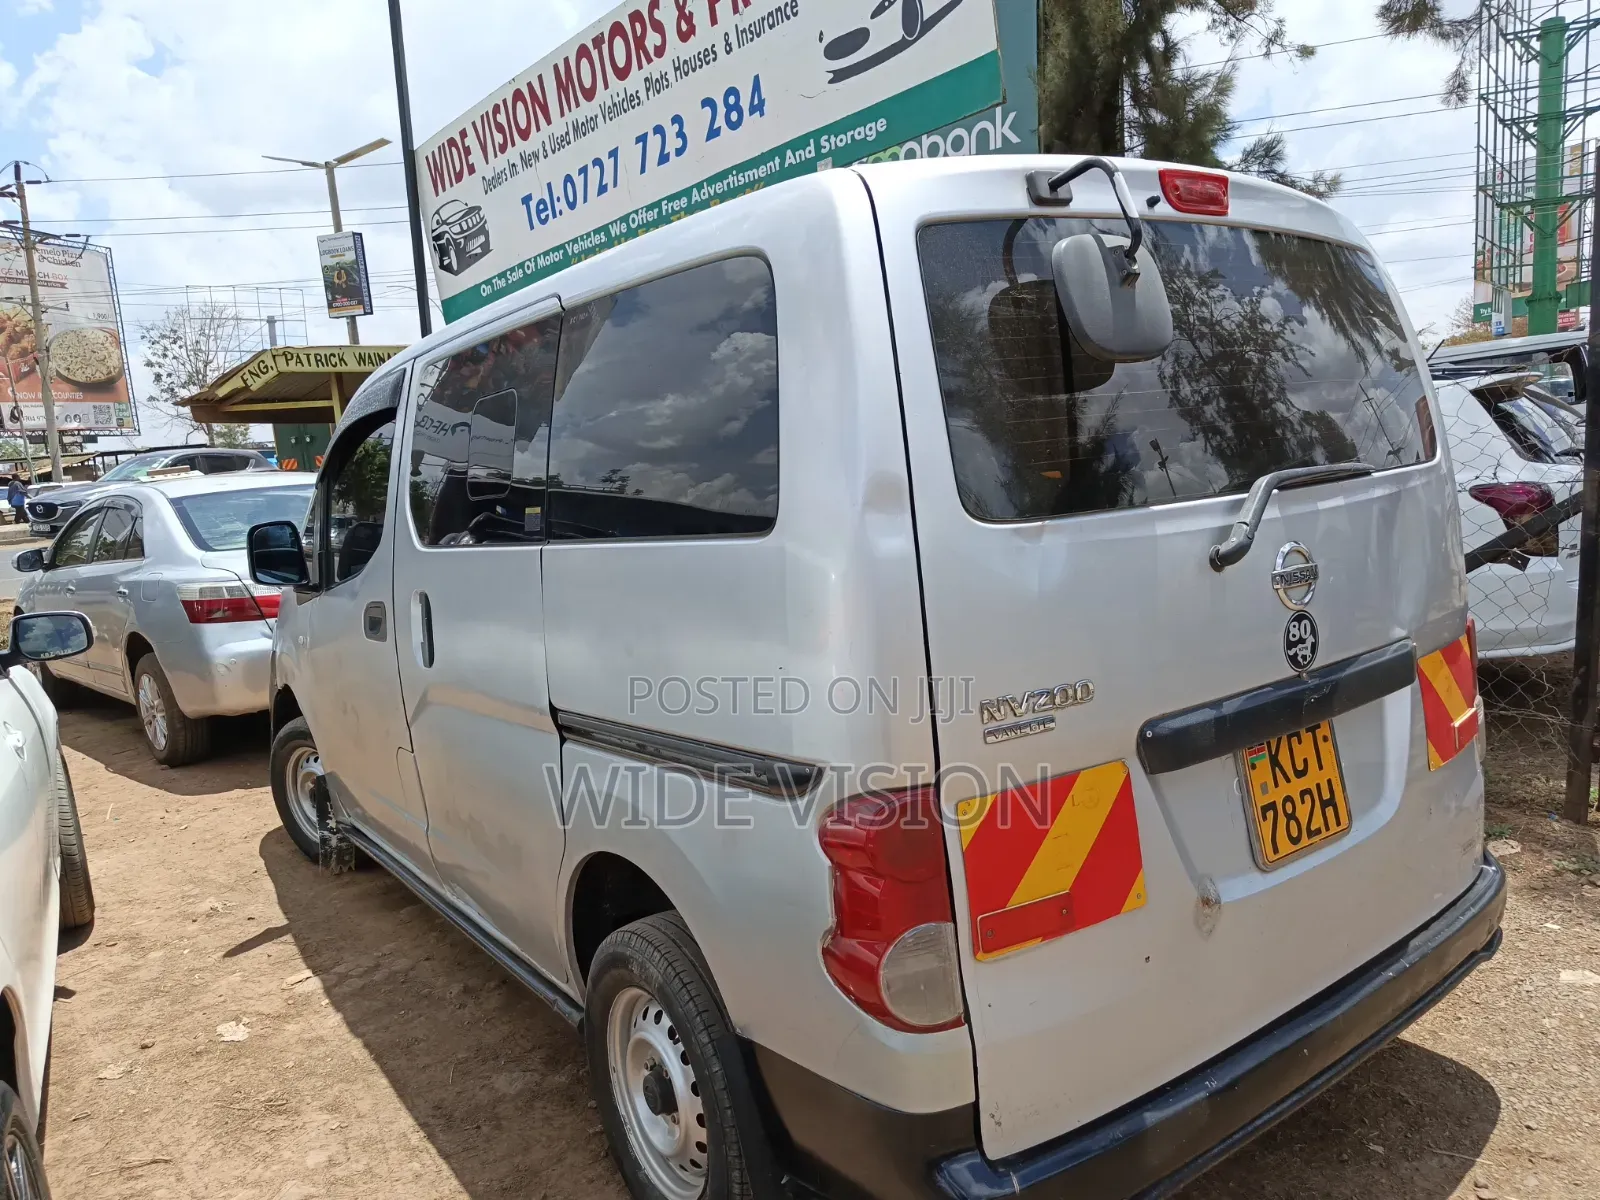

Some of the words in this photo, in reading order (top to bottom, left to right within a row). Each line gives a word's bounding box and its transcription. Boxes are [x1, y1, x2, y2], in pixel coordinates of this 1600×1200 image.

[425, 127, 476, 198] WIDE
[471, 73, 553, 166] VISION
[552, 0, 668, 119] MOTORS
[675, 0, 697, 43] &
[482, 167, 509, 196] Dealers
[507, 161, 520, 184] In:
[519, 149, 541, 172] New
[541, 140, 549, 160] &
[549, 131, 572, 156] Used
[572, 111, 600, 141] Motor
[599, 86, 645, 126] Vehicles,
[643, 71, 674, 102] Plots,
[672, 43, 718, 84] Houses
[723, 31, 734, 56] &
[735, 0, 800, 49] Insurance
[634, 113, 689, 176] 723
[700, 73, 767, 144] 284
[480, 284, 493, 298] On
[491, 275, 507, 293] The
[507, 265, 524, 286] Sale
[524, 257, 537, 276] Of
[536, 248, 565, 271] Motor
[565, 231, 609, 261] Vehicles,
[609, 218, 628, 239] We
[628, 205, 660, 229] Offer
[661, 193, 688, 216] Free
[690, 155, 781, 204] Advertisment
[784, 134, 817, 168] And
[819, 117, 888, 155] Storage
[46, 256, 82, 268] Chicken
[61, 250, 83, 260] Pizza
[15, 269, 50, 279] MUCH
[284, 350, 348, 369] PATRICK
[16, 392, 36, 400] NOW
[53, 391, 83, 400] COUNTIES
[1280, 564, 1318, 586] NISSAN
[1288, 619, 1312, 641] 80
[979, 677, 1096, 725] NV200
[1266, 723, 1324, 789] KCT
[1260, 778, 1342, 856] 782H
